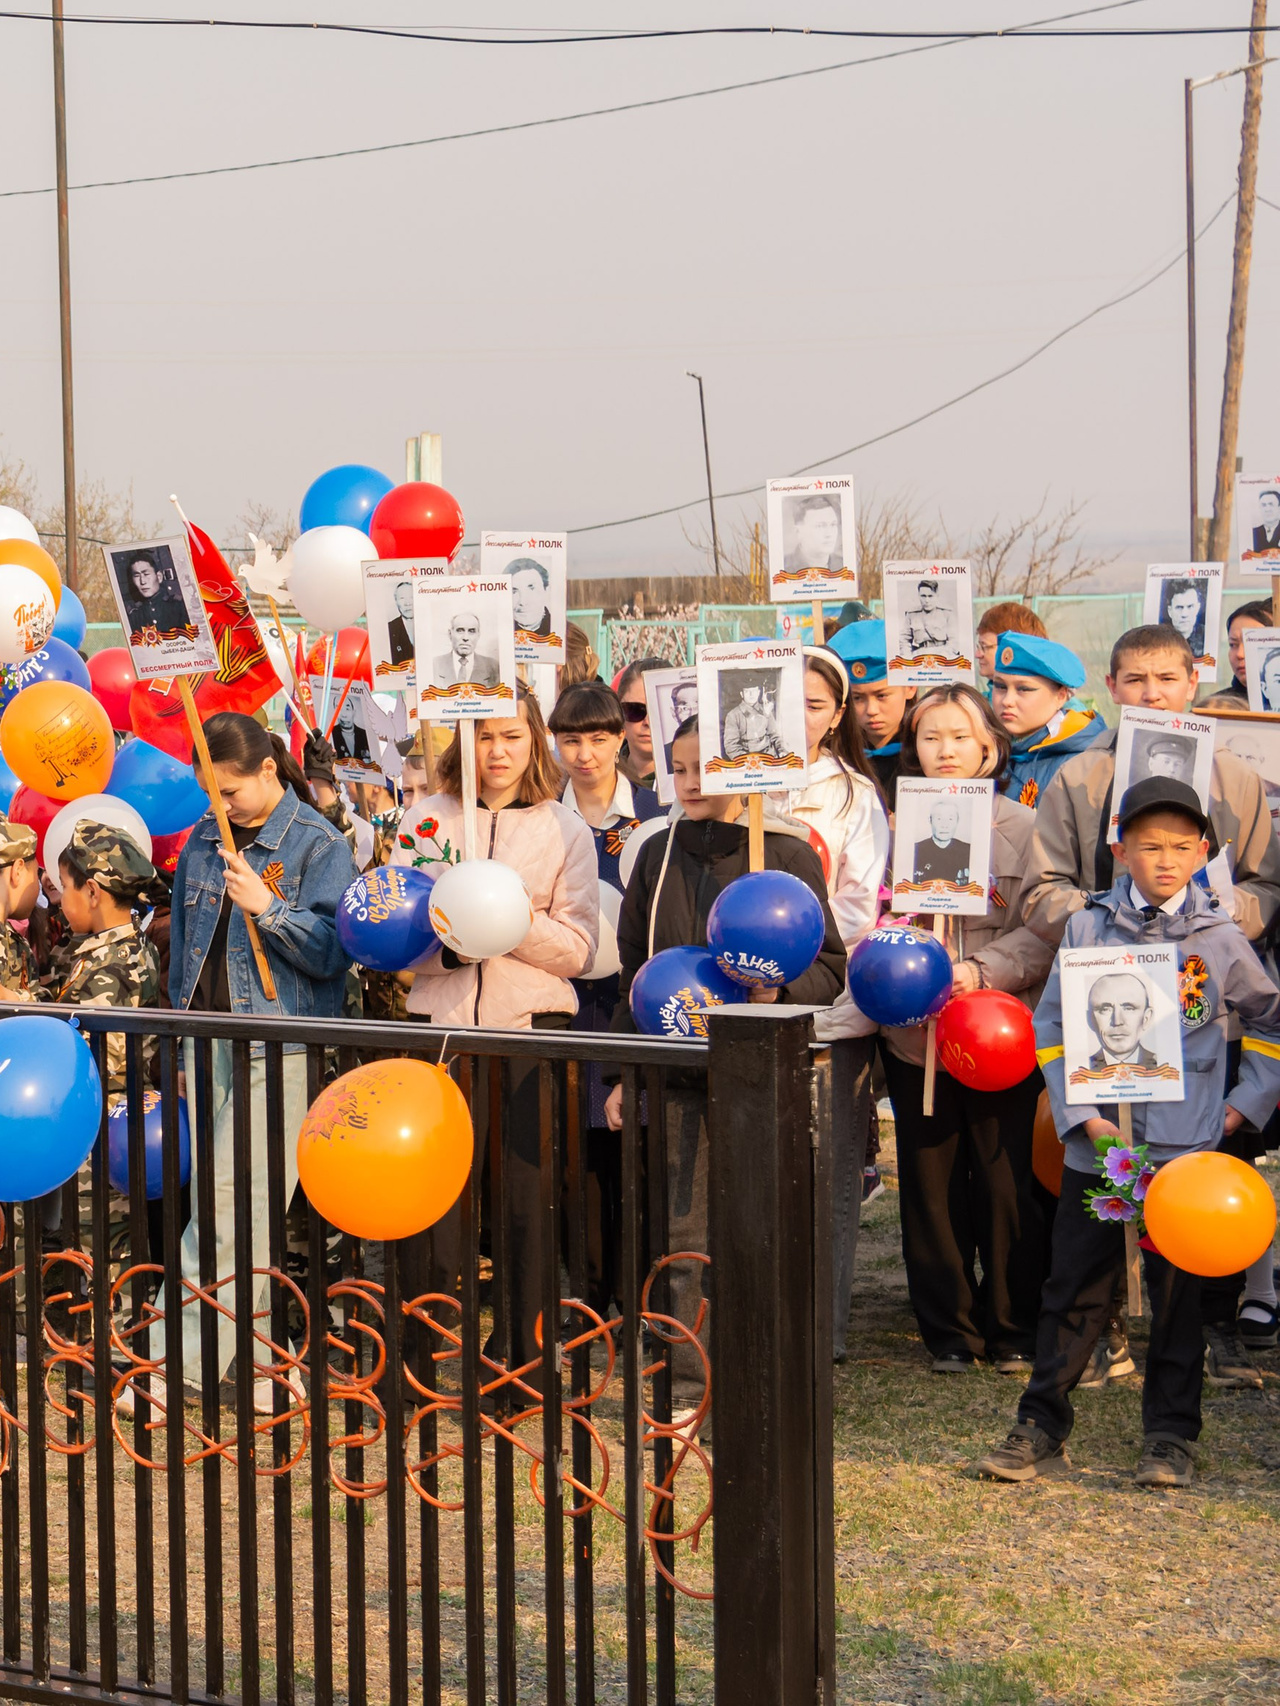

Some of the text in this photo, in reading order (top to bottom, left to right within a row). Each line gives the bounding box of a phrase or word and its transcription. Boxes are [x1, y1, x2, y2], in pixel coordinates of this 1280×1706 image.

[825, 480, 850, 489] ПОЛК
[538, 540, 563, 549] ПОЛК
[420, 567, 445, 576] ПОЛК
[941, 566, 966, 574] ПОЛК
[1198, 569, 1221, 577] ПОЛК
[480, 582, 508, 592] ПОЛК
[161, 646, 196, 655] ЦЫБЕН-ДАШИ
[767, 647, 796, 658] ПОЛК
[141, 659, 214, 674] БЕССМЕРТНЫЙ ПОЛК
[350, 687, 364, 695] ПОЛ
[1184, 721, 1211, 733] ПОЛК
[961, 786, 987, 794] ПОЛК
[357, 907, 368, 921] С
[724, 951, 734, 964] С
[1064, 953, 1170, 968] бессмертный ПОЛК
